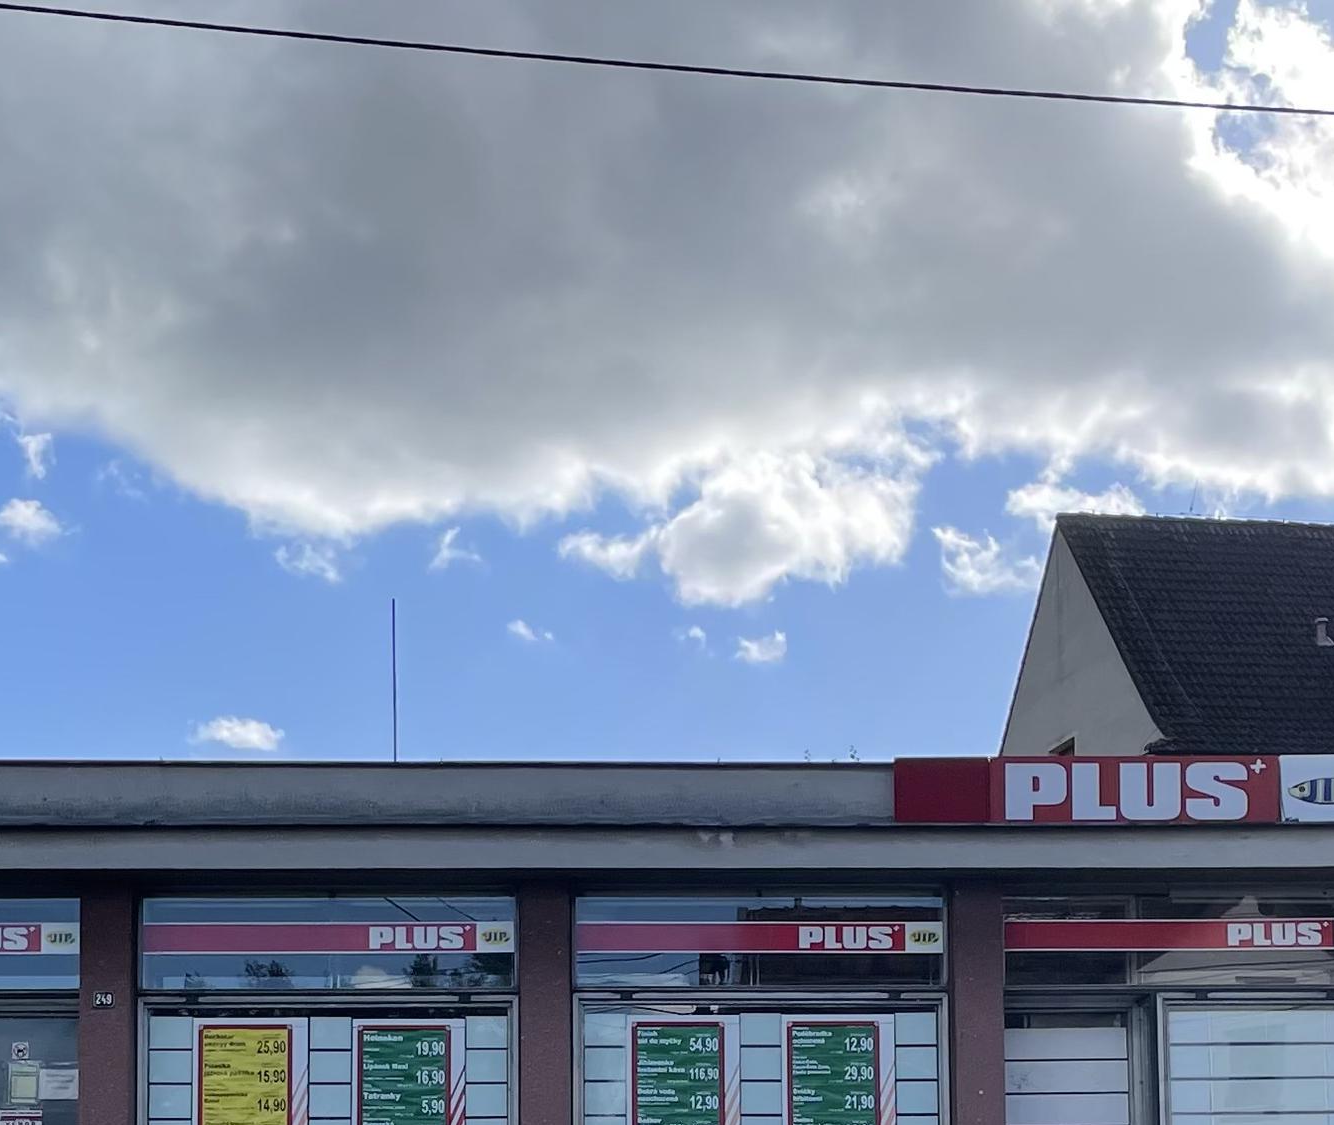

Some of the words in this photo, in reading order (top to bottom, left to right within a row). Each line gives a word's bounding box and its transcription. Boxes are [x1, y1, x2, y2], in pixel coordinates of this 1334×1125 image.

[95, 993, 112, 1005] 249
[257, 1040, 286, 1055] 25,90
[415, 1041, 445, 1057] 19,90
[689, 1037, 719, 1053] 54,90
[844, 1037, 874, 1053] 12,90
[415, 1070, 445, 1086] 16,90
[689, 1067, 719, 1082] 116,90
[844, 1066, 874, 1082] 29,90
[257, 1098, 286, 1113] 14,90
[421, 1099, 445, 1115] 5,90
[689, 1095, 719, 1112] 12,90
[844, 1095, 874, 1111] 21,90
